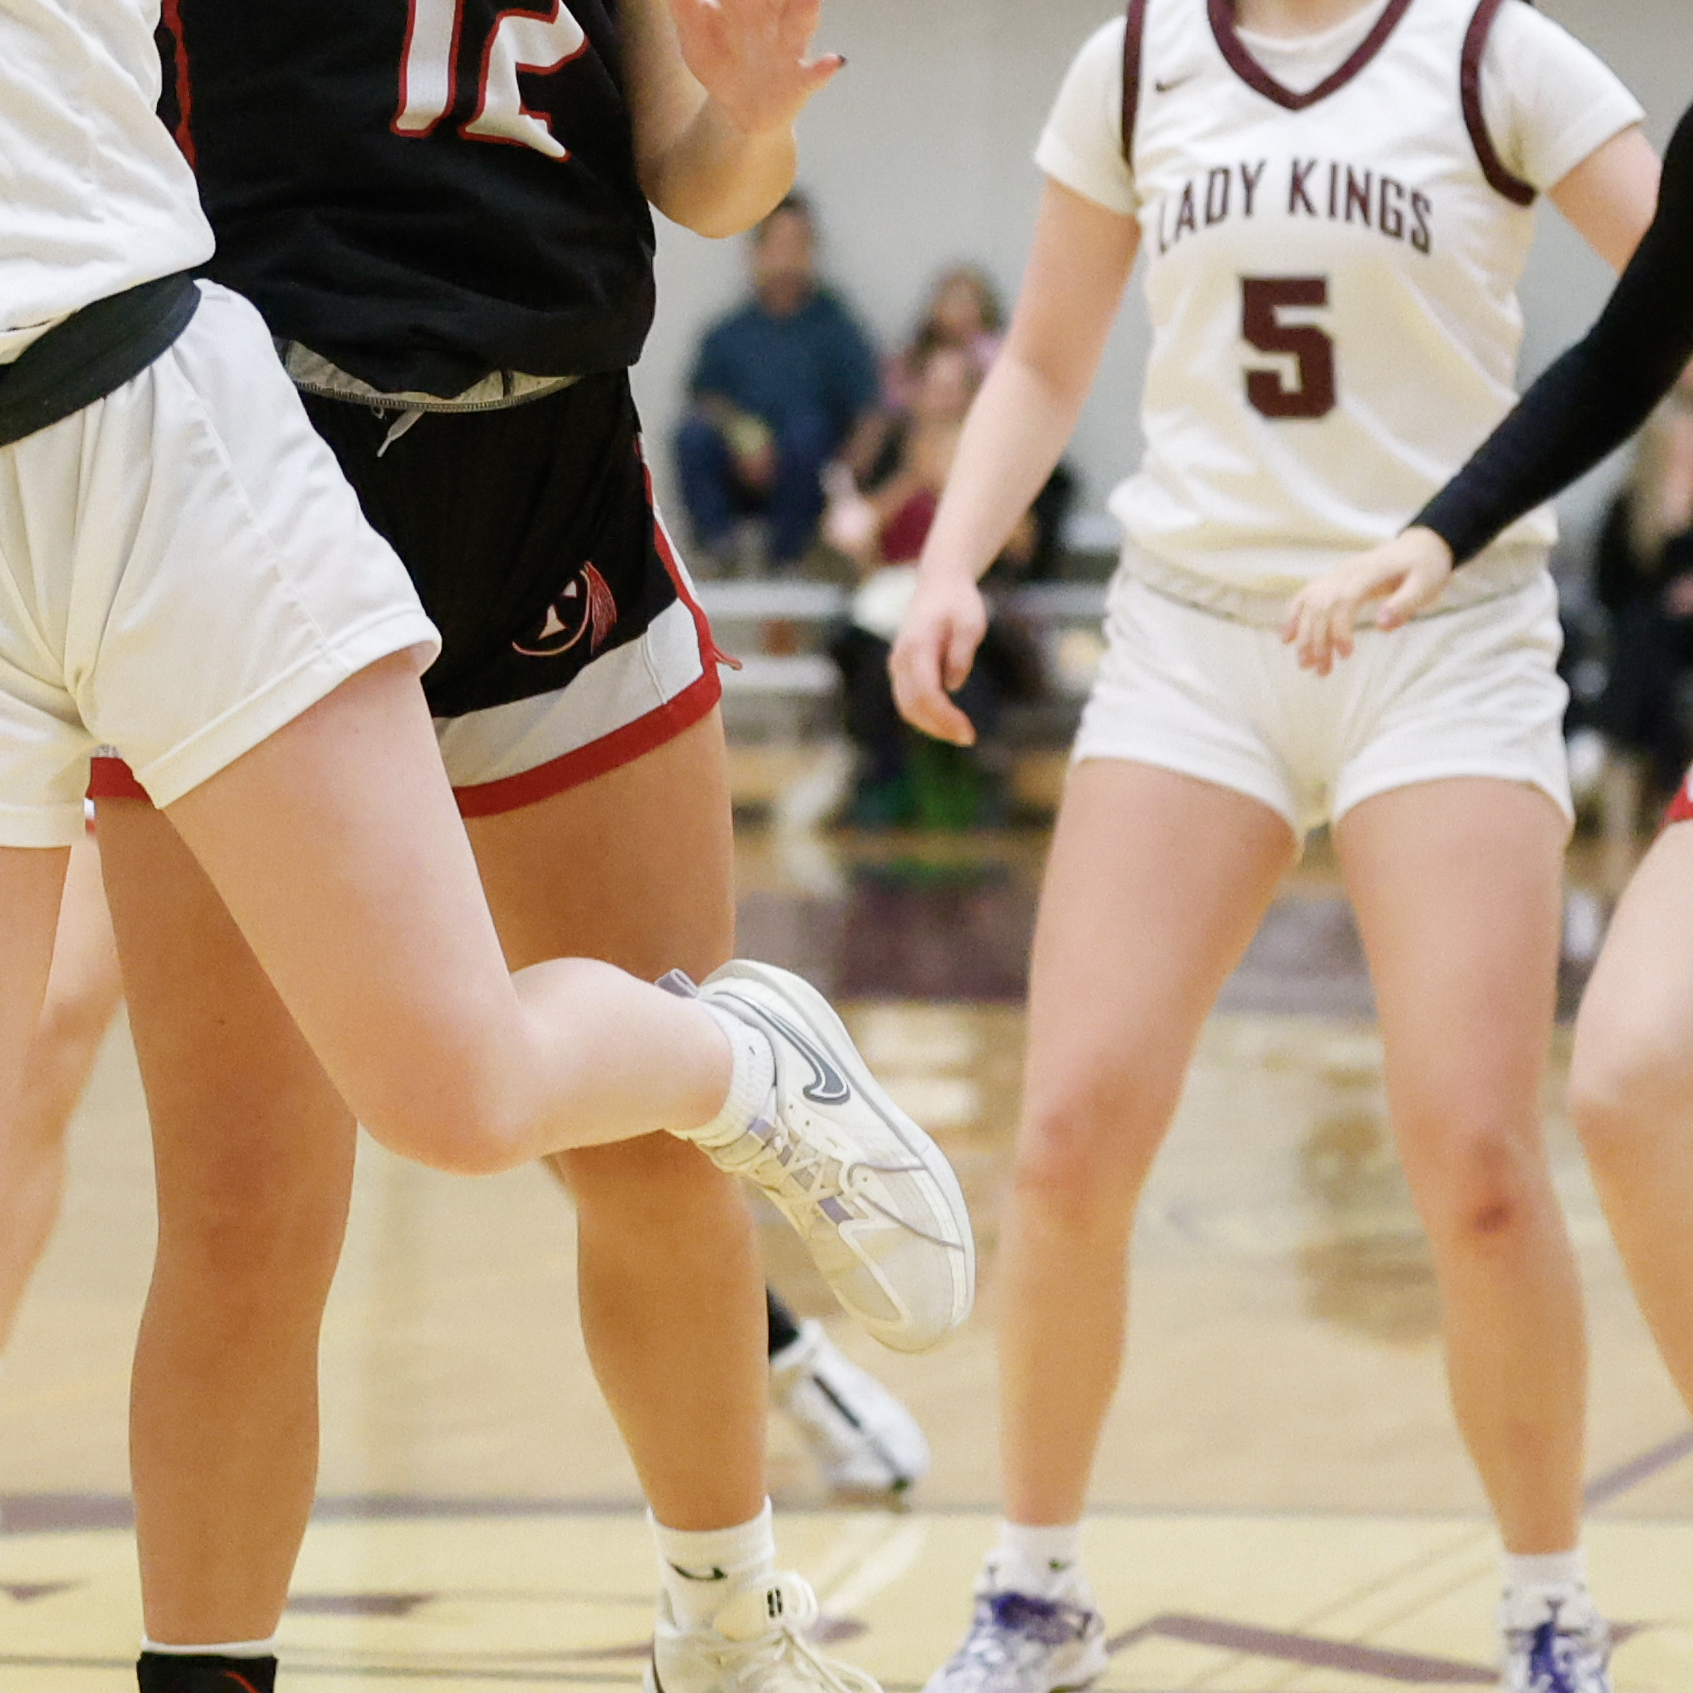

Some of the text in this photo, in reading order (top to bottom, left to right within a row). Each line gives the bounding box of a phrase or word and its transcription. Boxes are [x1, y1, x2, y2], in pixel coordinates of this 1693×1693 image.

[1158, 159, 1433, 256] LADY KINGS
[1240, 274, 1338, 423] 5
